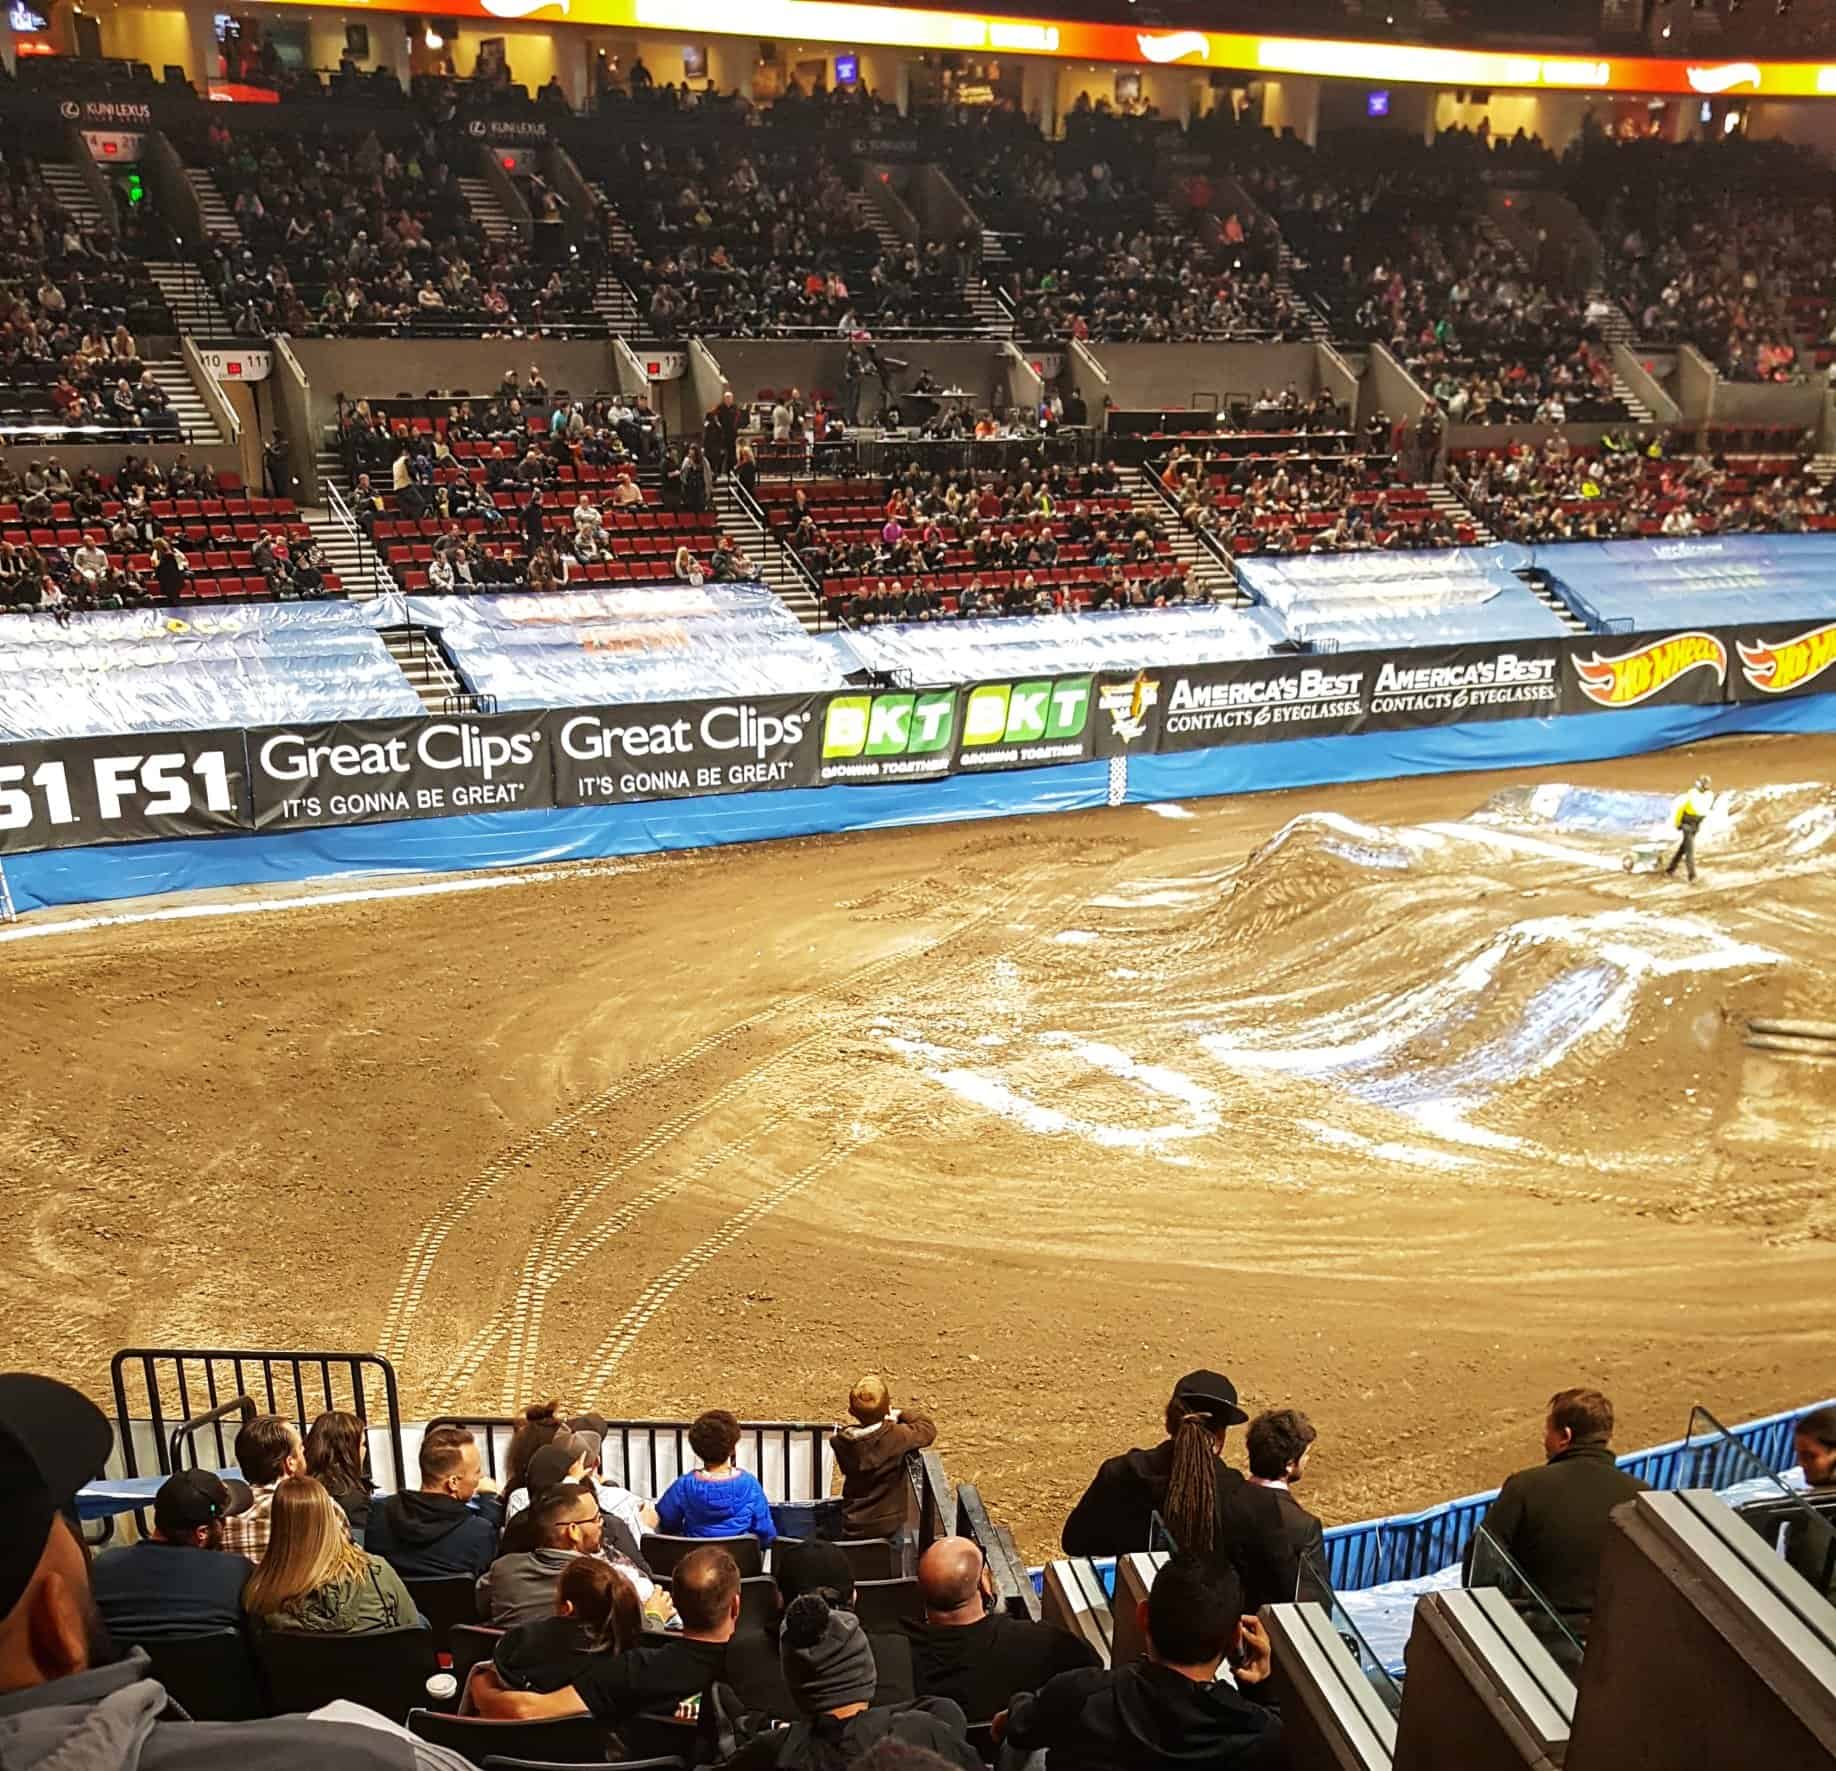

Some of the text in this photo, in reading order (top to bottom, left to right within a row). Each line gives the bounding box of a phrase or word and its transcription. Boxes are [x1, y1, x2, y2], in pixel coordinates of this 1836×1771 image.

[247, 355, 270, 368] 111
[1298, 669, 1363, 698] BEST
[1496, 654, 1556, 682] BEST
[965, 689, 1088, 735] BKT
[1371, 694, 1451, 713] CONTACTS
[560, 715, 693, 760] Great
[825, 702, 951, 746] BKT
[1166, 711, 1251, 733] CONTACTS
[260, 734, 410, 780] Great
[578, 763, 789, 797] IT'S GONNA BE GREAT
[283, 783, 519, 818] IT'S GONNA BE GREAT
